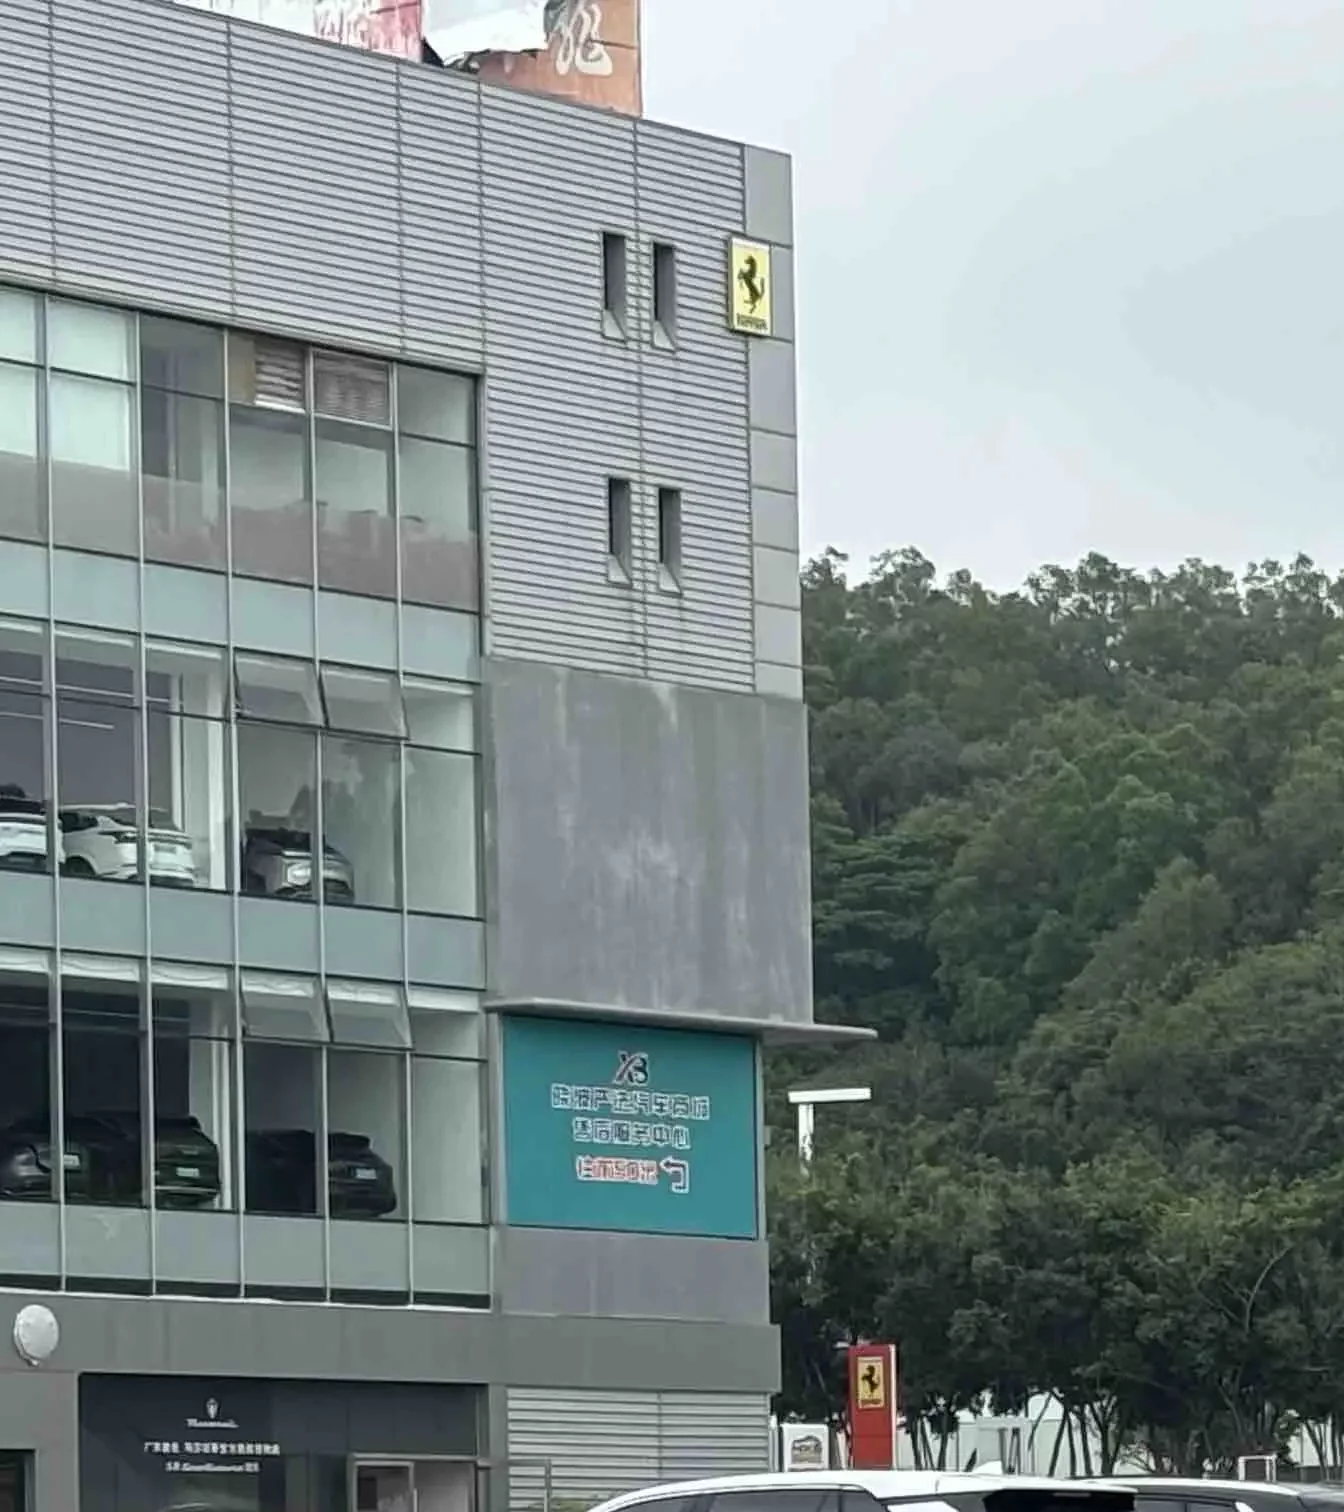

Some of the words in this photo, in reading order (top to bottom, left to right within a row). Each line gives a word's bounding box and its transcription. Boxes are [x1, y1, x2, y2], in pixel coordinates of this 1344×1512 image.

[573, 1117, 691, 1150] 售后服务中心
